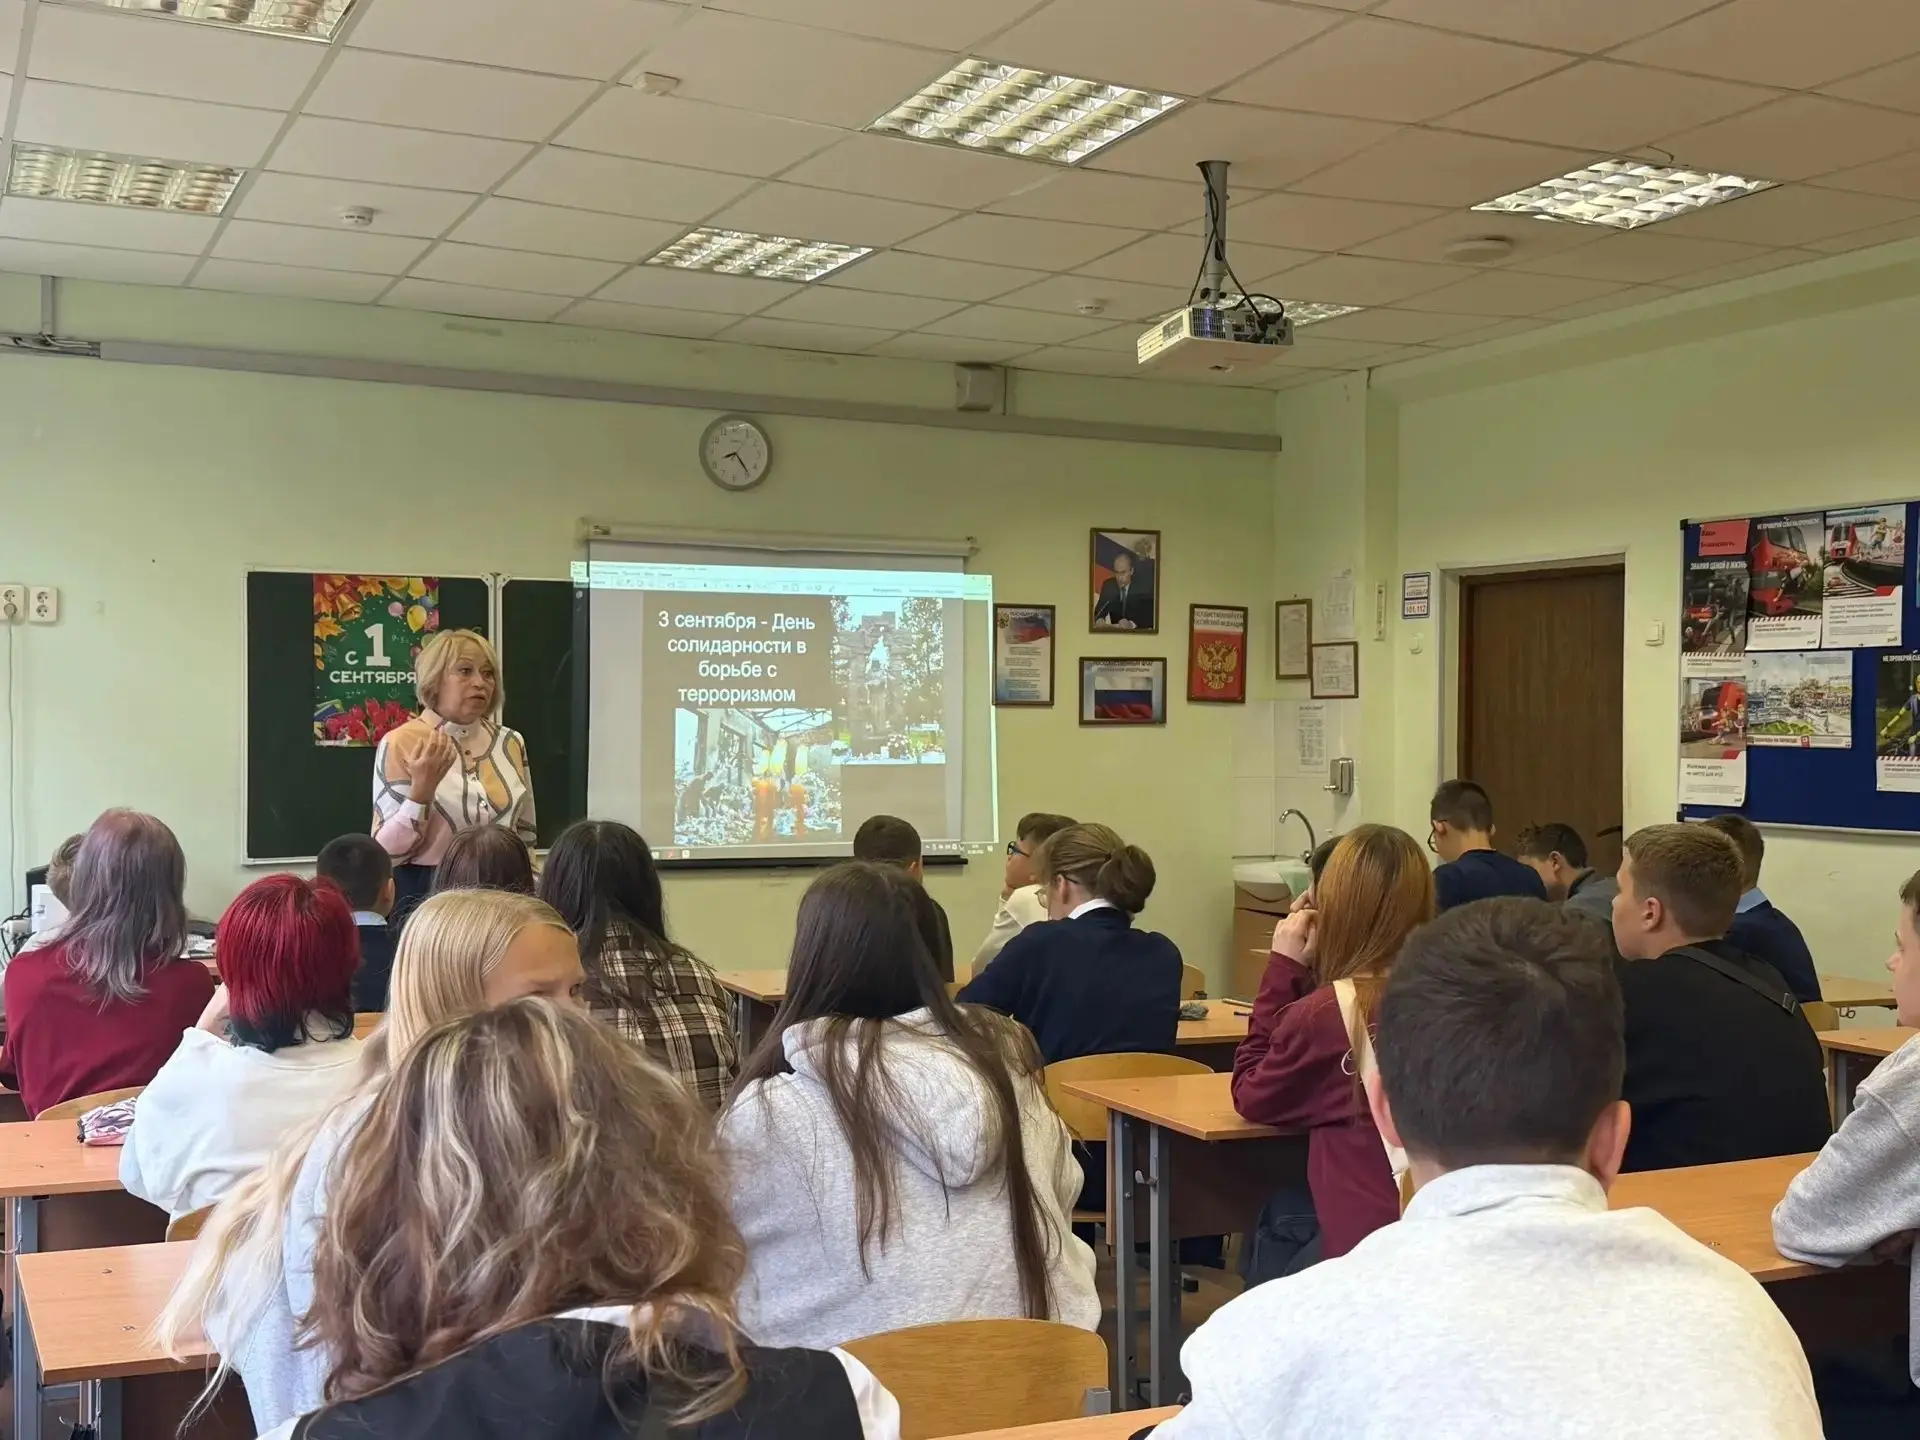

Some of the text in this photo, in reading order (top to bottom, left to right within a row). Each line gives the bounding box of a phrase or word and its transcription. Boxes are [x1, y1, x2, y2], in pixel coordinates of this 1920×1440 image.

[658, 610, 669, 628] 3
[674, 612, 756, 632] сентября
[771, 613, 816, 633] День
[364, 623, 391, 667] 1
[668, 638, 807, 657] солидарности в
[329, 671, 417, 684] СЕНТЯБРЯ
[698, 660, 777, 680] борьбе с
[677, 687, 796, 706] терроризмом
